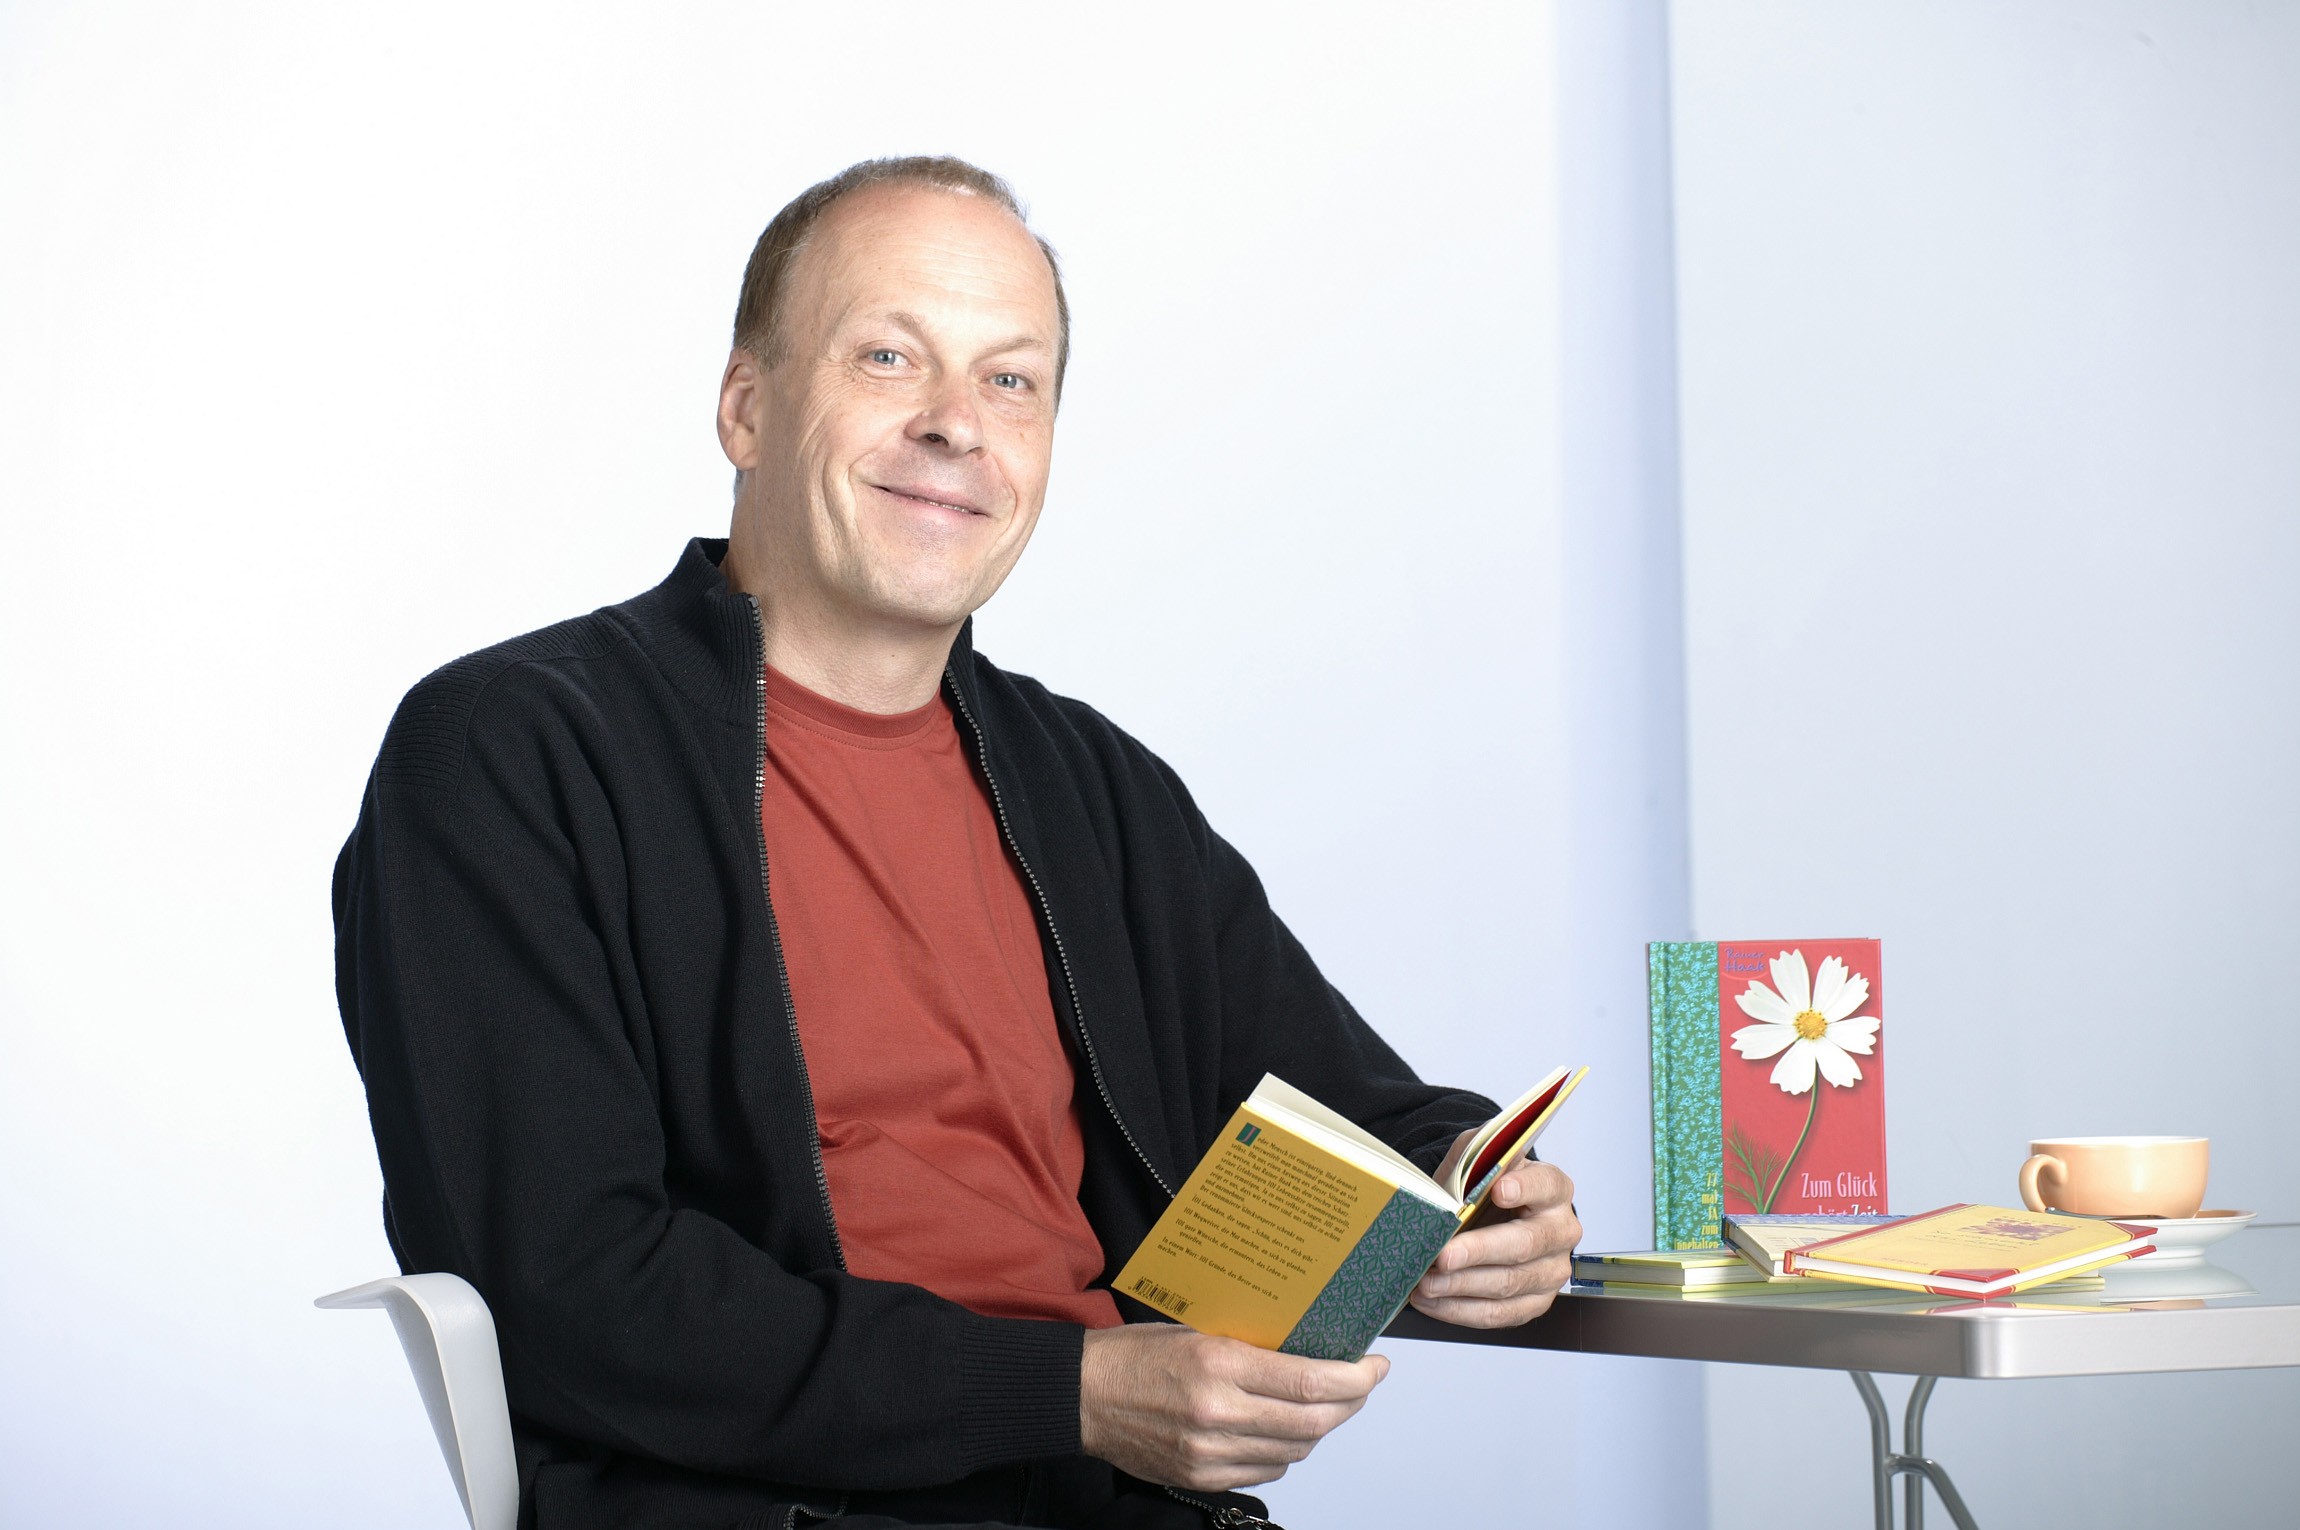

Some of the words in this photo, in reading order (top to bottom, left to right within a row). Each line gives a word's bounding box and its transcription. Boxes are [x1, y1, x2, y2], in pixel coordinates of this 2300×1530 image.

[1725, 960, 1765, 972] Haak
[1203, 1176, 1216, 1187] und
[1214, 1162, 1225, 1172] die
[1222, 1168, 1234, 1177] uns
[1261, 1187, 1269, 1195] Ja
[1274, 1195, 1285, 1203] uns
[1283, 1198, 1301, 1211] selbst
[1219, 1156, 1237, 1168] seiner
[1235, 1164, 1268, 1185] Erfahrungen
[1246, 1150, 1258, 1160] Um
[1255, 1155, 1268, 1165] uns
[1266, 1161, 1282, 1172] einen
[1300, 1179, 1311, 1188] aus
[1310, 1183, 1328, 1196] dieser
[1326, 1192, 1351, 1209] Situation
[1251, 1142, 1281, 1162] verzweifelt
[1278, 1158, 1292, 1168] man
[1290, 1163, 1318, 1181] manchmal
[1346, 1192, 1359, 1203] sich
[1251, 1162, 1262, 1172] hat
[1260, 1167, 1279, 1181] Rainer
[1277, 1176, 1292, 1187] Haak
[1290, 1184, 1302, 1193] aus
[1300, 1188, 1314, 1199] dem
[1311, 1194, 1333, 1208] reichen
[1330, 1204, 1350, 1217] Schatz
[1268, 1141, 1290, 1156] Mensch
[1287, 1152, 1297, 1160] ist
[1323, 1170, 1337, 1181] Und
[1334, 1176, 1358, 1192] dennoch
[1801, 1172, 1832, 1198] Zum
[1837, 1171, 1877, 1198] Glück
[1198, 1183, 1210, 1193] Der
[1208, 1189, 1242, 1210] renommierte
[1274, 1223, 1297, 1238] schenkt
[1294, 1234, 1306, 1243] uns
[1208, 1170, 1224, 1182] zeigt
[1239, 1185, 1253, 1196] dass
[1250, 1192, 1262, 1201] wir
[1266, 1200, 1281, 1211] wert
[1291, 1213, 1303, 1222] uns
[1301, 1218, 1319, 1230] selbst
[1323, 1229, 1342, 1243] achten
[1701, 1189, 1718, 1204] mal
[1182, 1223, 1197, 1234] gute
[1218, 1240, 1230, 1250] die
[1254, 1259, 1267, 1269] das
[1264, 1264, 1283, 1278] Leben
[1279, 1273, 1289, 1281] zu
[1219, 1225, 1231, 1235] die
[1228, 1230, 1242, 1241] Mut
[1267, 1250, 1281, 1261] sich
[1225, 1213, 1237, 1222] die
[1270, 1237, 1285, 1248] dass
[1282, 1244, 1291, 1252] es
[1289, 1246, 1303, 1257] dich
[1701, 1225, 1719, 1235] zum
[1160, 1235, 1170, 1244] In
[1167, 1239, 1185, 1252] einem
[1226, 1269, 1239, 1279] das
[1235, 1274, 1253, 1287] Beste
[1250, 1283, 1262, 1292] aus
[1259, 1287, 1274, 1297] sich
[1270, 1293, 1279, 1301] zu
